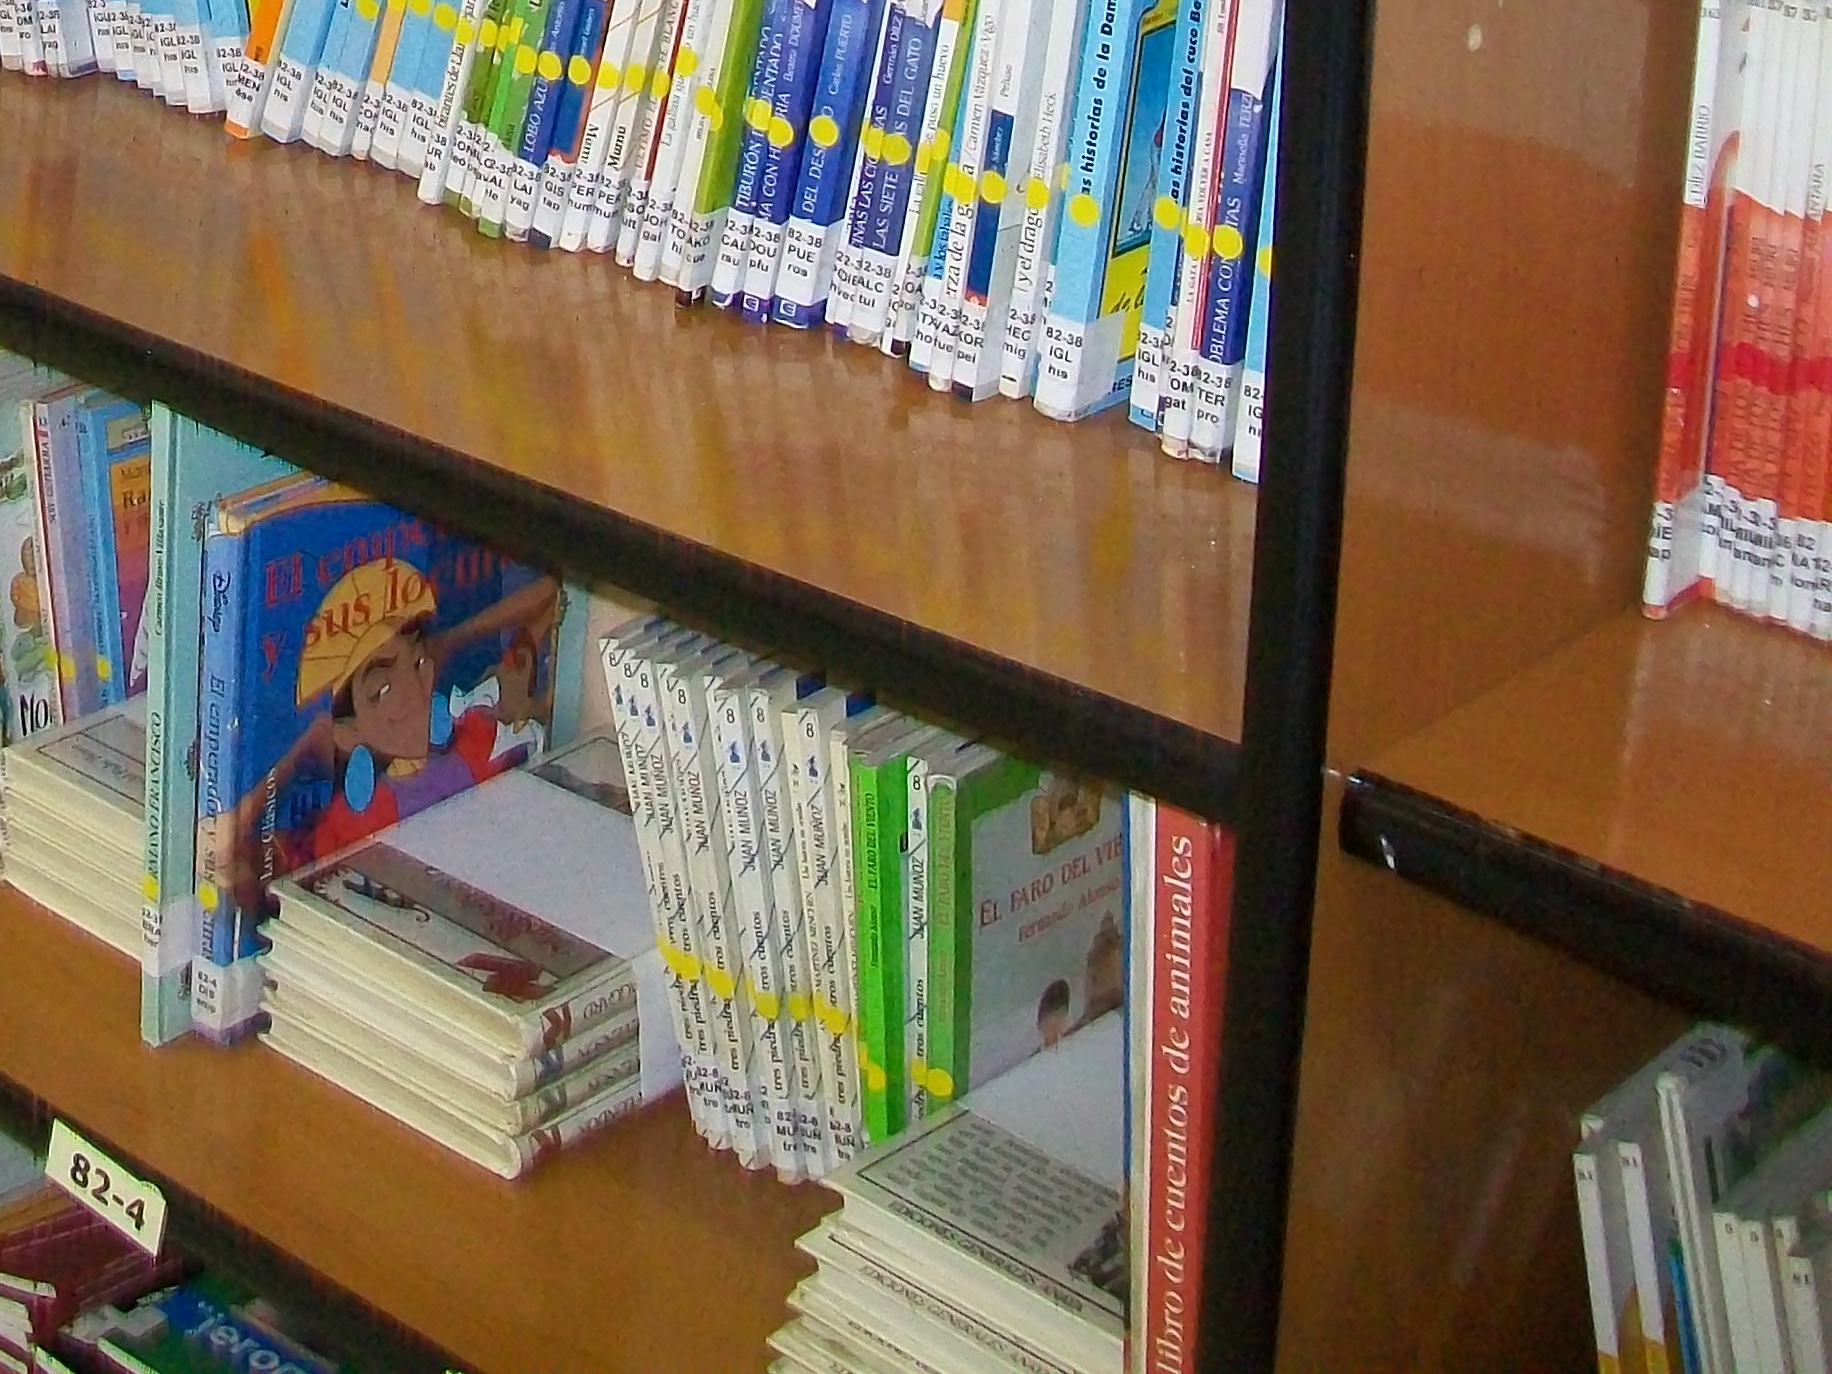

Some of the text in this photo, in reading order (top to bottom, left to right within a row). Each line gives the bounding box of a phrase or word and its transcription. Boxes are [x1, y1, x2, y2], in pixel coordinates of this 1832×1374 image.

[1097, 41, 1110, 64] la
[1092, 69, 1108, 93] de
[1080, 98, 1104, 182] historias
[787, 245, 814, 264] PUE
[1048, 364, 1067, 380] his
[1049, 345, 1073, 363] IGL
[303, 590, 371, 646] sus
[978, 900, 999, 928] EL
[1008, 871, 1054, 916] FARO
[1059, 855, 1093, 890] DEL
[1161, 834, 1195, 1002] animales
[1169, 1025, 1190, 1073] de
[1159, 1080, 1188, 1232] cuentos
[69, 1151, 147, 1232] 82-4
[1160, 1244, 1182, 1293] de
